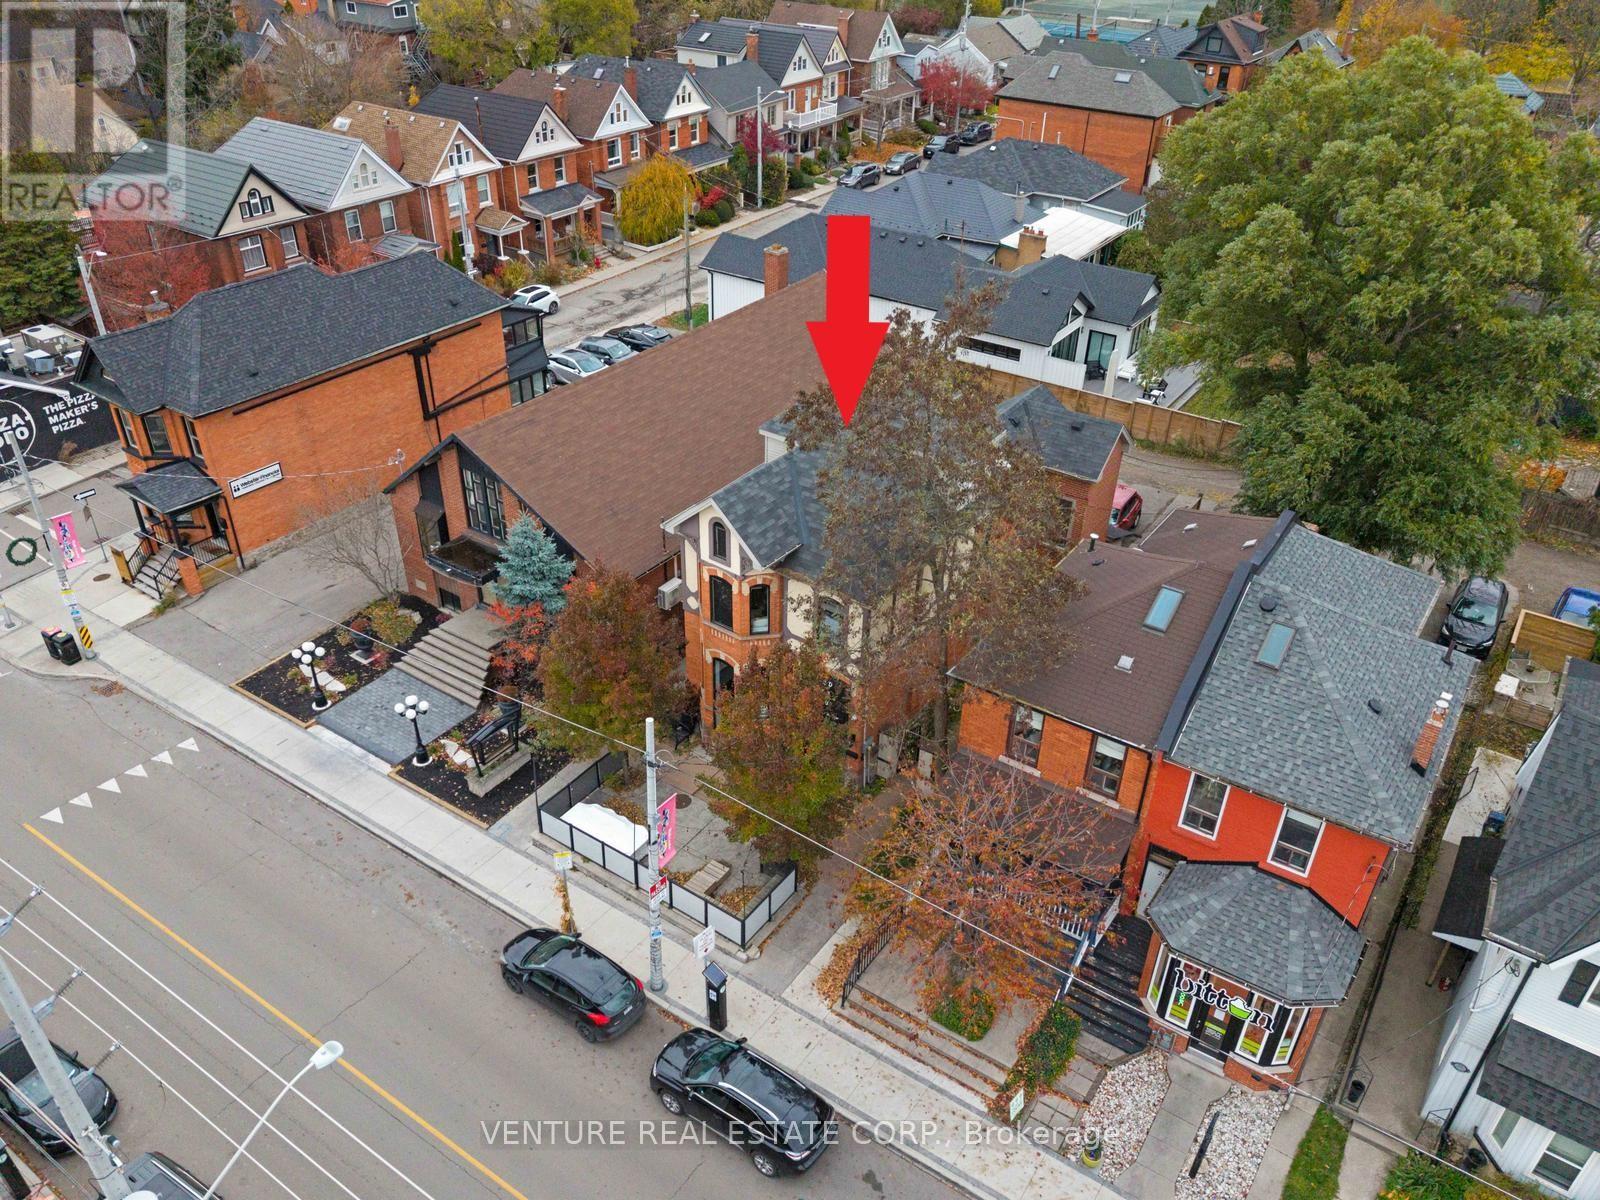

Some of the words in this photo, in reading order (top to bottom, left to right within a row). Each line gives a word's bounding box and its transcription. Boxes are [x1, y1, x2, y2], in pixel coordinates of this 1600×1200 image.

[43, 401, 66, 414] THE
[48, 401, 98, 424] MAKER'S
[52, 417, 86, 434] PIZZA.
